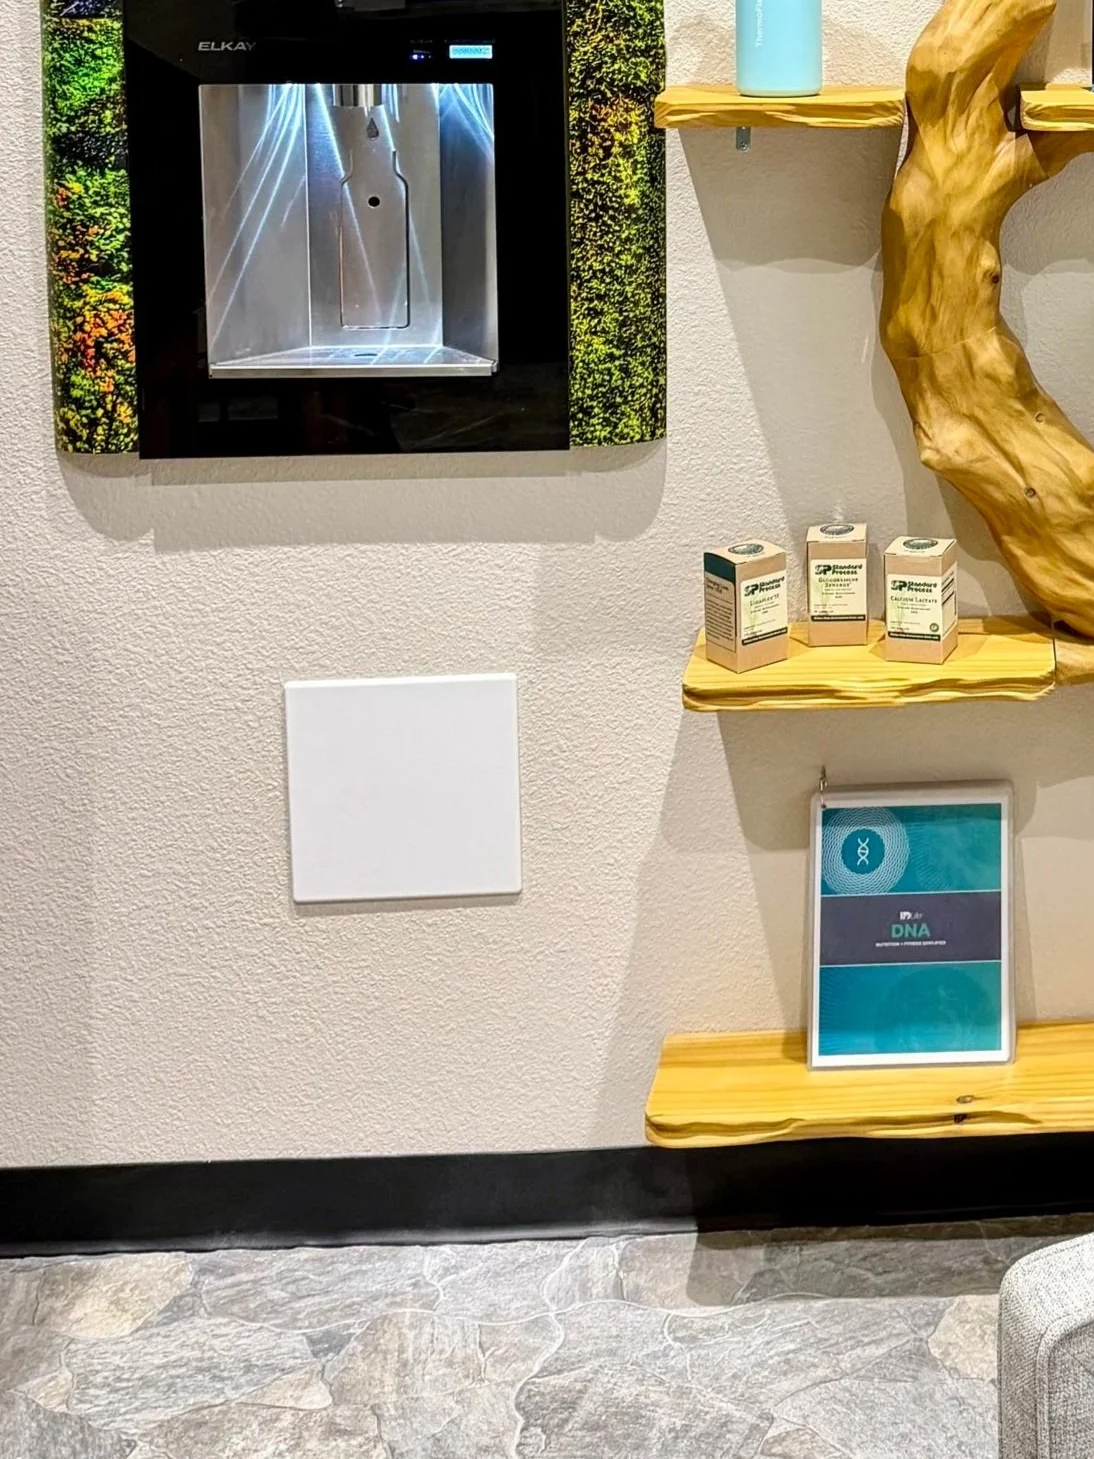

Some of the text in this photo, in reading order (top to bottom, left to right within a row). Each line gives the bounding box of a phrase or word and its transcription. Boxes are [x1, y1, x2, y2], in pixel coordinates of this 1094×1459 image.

[198, 41, 256, 51] ELKAY
[760, 576, 784, 587] Standard
[759, 583, 780, 593] Process
[891, 923, 930, 938] DNA
